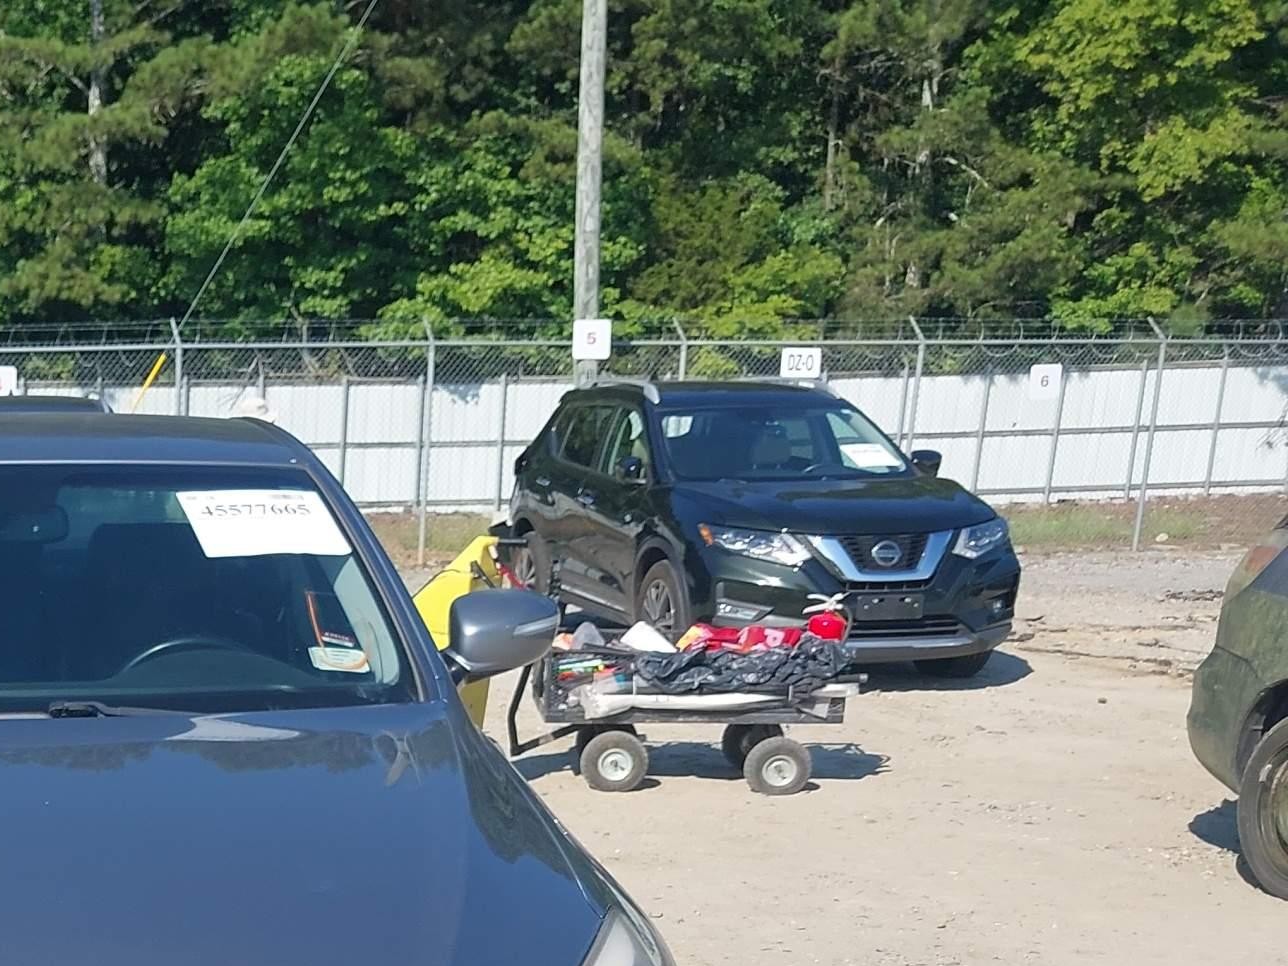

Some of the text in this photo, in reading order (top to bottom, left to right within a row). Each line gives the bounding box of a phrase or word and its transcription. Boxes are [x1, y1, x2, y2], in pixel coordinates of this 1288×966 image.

[586, 331, 597, 345] 5
[1040, 375, 1049, 388] 6
[201, 503, 312, 517] 45577665
